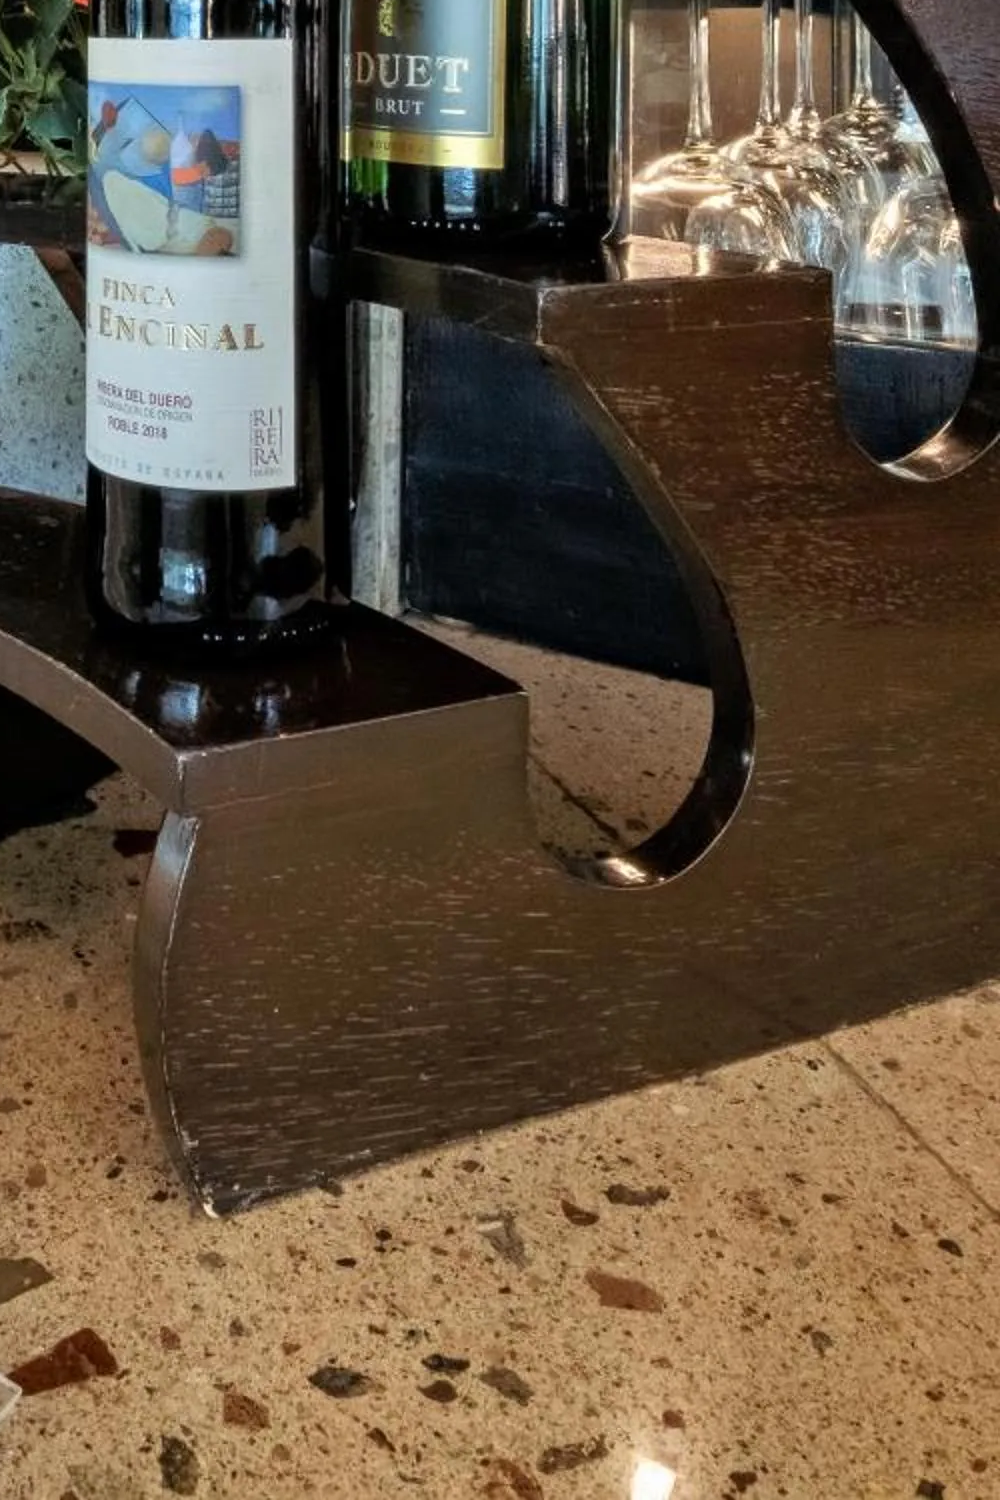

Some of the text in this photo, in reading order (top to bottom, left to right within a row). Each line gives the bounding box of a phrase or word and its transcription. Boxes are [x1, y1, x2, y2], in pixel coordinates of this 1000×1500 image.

[355, 51, 469, 94] DUET
[375, 97, 425, 115] BRUT
[103, 276, 176, 307] FINCA
[99, 303, 265, 351] ENCINAL
[125, 387, 145, 405] DEL
[149, 392, 193, 410] DUERO
[107, 415, 139, 435] ROBLE
